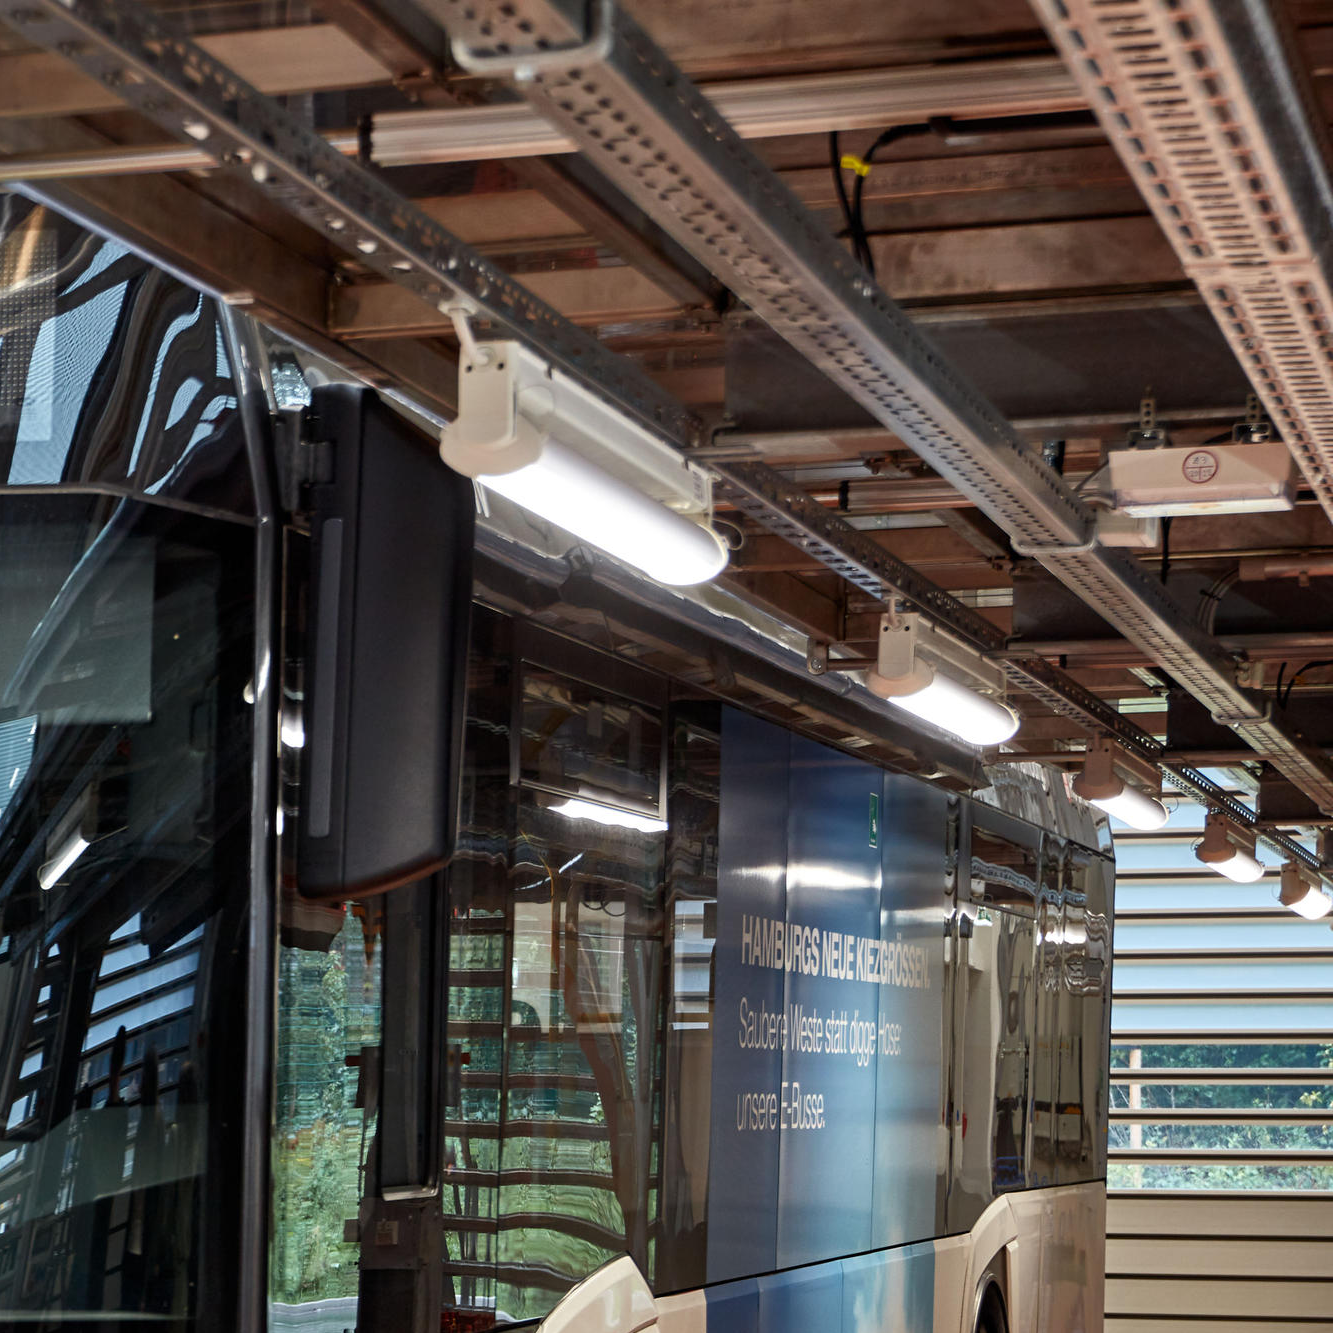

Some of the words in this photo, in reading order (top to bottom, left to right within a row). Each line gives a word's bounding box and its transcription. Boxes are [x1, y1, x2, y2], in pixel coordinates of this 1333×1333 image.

[741, 914, 819, 976] HAMBURGS
[822, 930, 855, 981] NEUE
[856, 932, 931, 989] KIEZGRÖSSEN.
[738, 997, 788, 1050] Saubere
[790, 1004, 823, 1053] Weste
[825, 1010, 848, 1054] statt
[737, 1093, 777, 1131] unsere
[780, 1082, 826, 1129] E-Busse.
